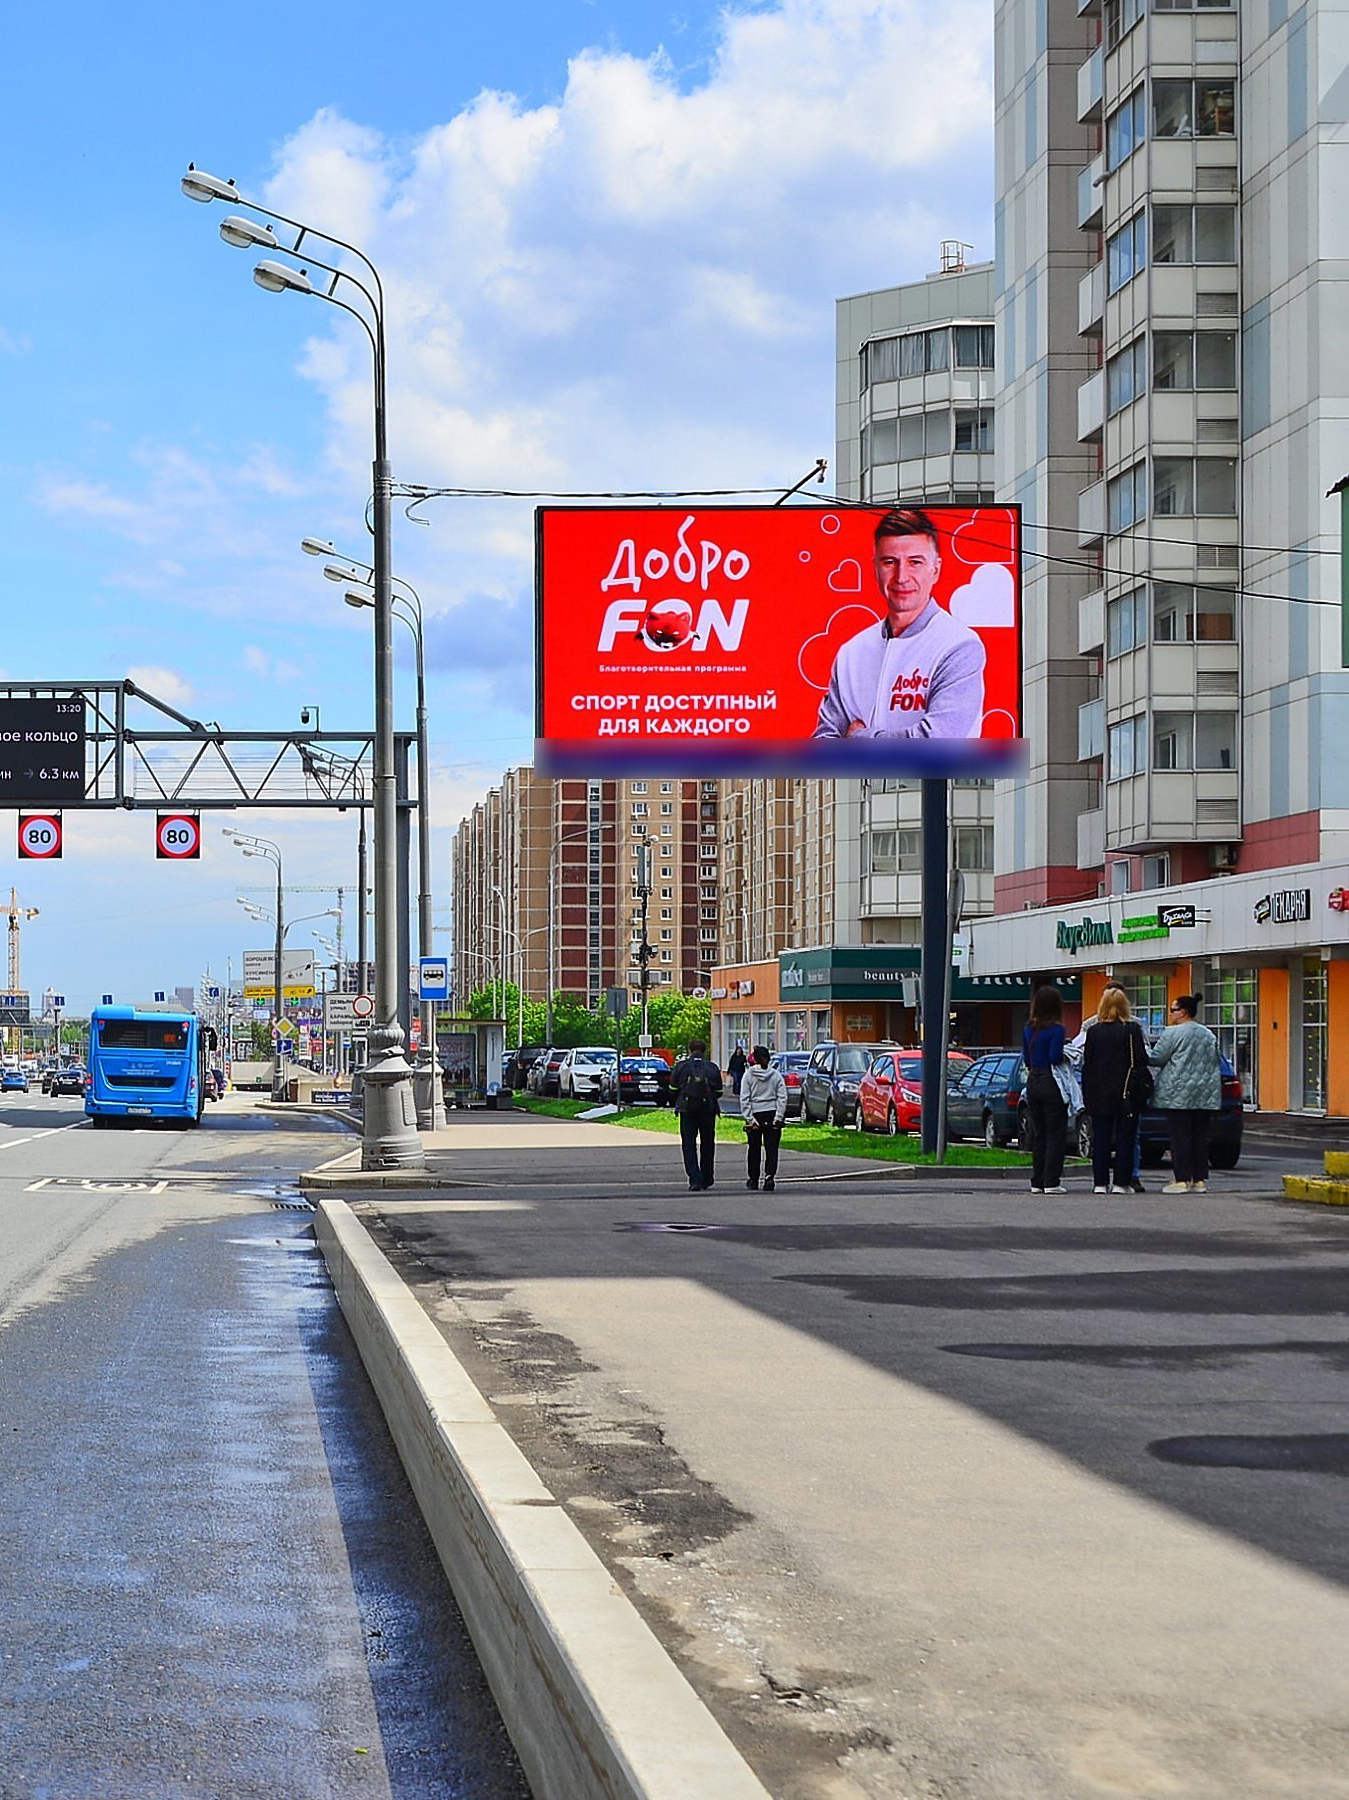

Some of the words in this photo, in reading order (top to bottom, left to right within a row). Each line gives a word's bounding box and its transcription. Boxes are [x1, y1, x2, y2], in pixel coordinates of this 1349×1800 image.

[600, 515, 750, 593] Добро
[597, 598, 750, 652] FON
[598, 664, 692, 673] Благотворительная
[694, 664, 747, 674] программа
[56, 704, 82, 713] 13:20
[571, 695, 641, 711] СПОРТ
[644, 690, 778, 713] ДОСТУПНЫЙ
[889, 693, 928, 711] FON
[598, 719, 640, 736] ДЛЯ
[646, 717, 751, 736] КАЖДОГО
[25, 730, 78, 744] кольцо
[39, 768, 59, 780] 6.3
[62, 770, 80, 780] км
[28, 829, 52, 845] 80
[166, 829, 190, 845] 80
[864, 970, 907, 982] beauty
